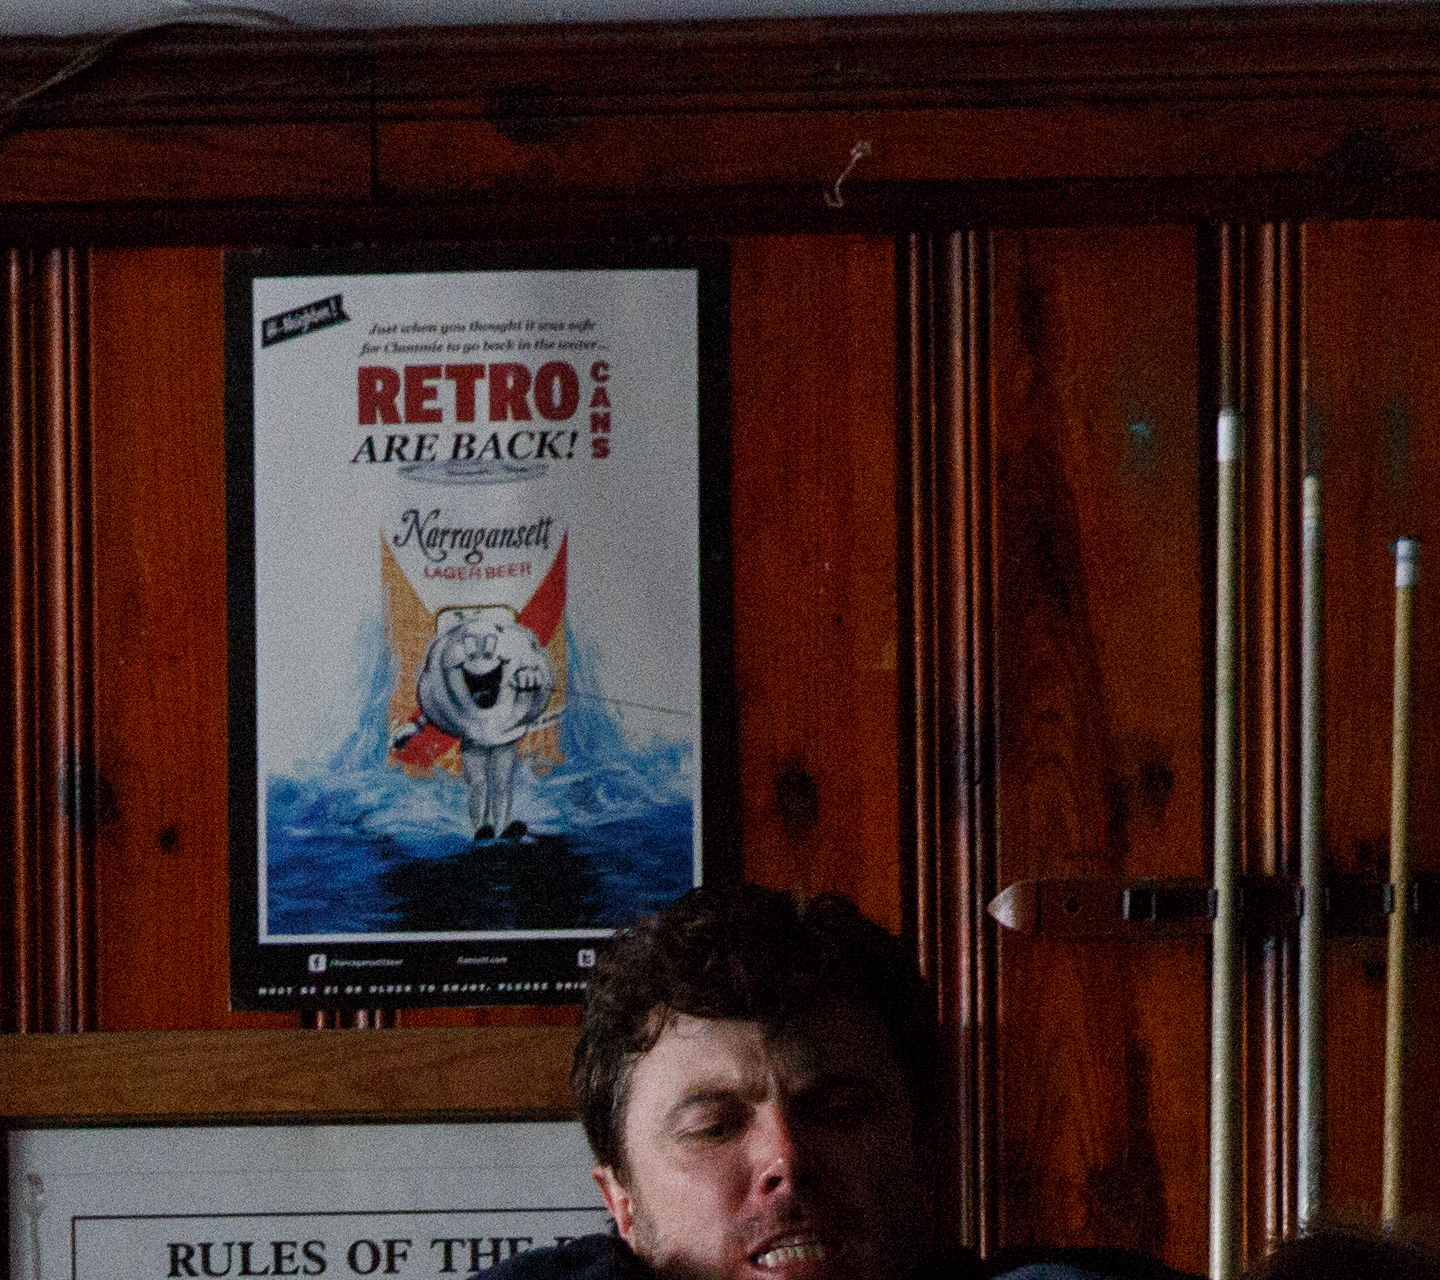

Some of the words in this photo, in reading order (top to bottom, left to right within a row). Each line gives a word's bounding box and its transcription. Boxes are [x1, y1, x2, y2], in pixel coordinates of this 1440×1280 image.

[358, 361, 580, 426] RETRO
[589, 360, 612, 460] CANS
[350, 432, 439, 464] ARE
[451, 430, 579, 461] BACK!
[392, 507, 554, 566] Narragansett
[423, 563, 482, 581] LAGER
[484, 561, 532, 579] BEER
[165, 1240, 328, 1278] RULES
[346, 1239, 413, 1276] OF
